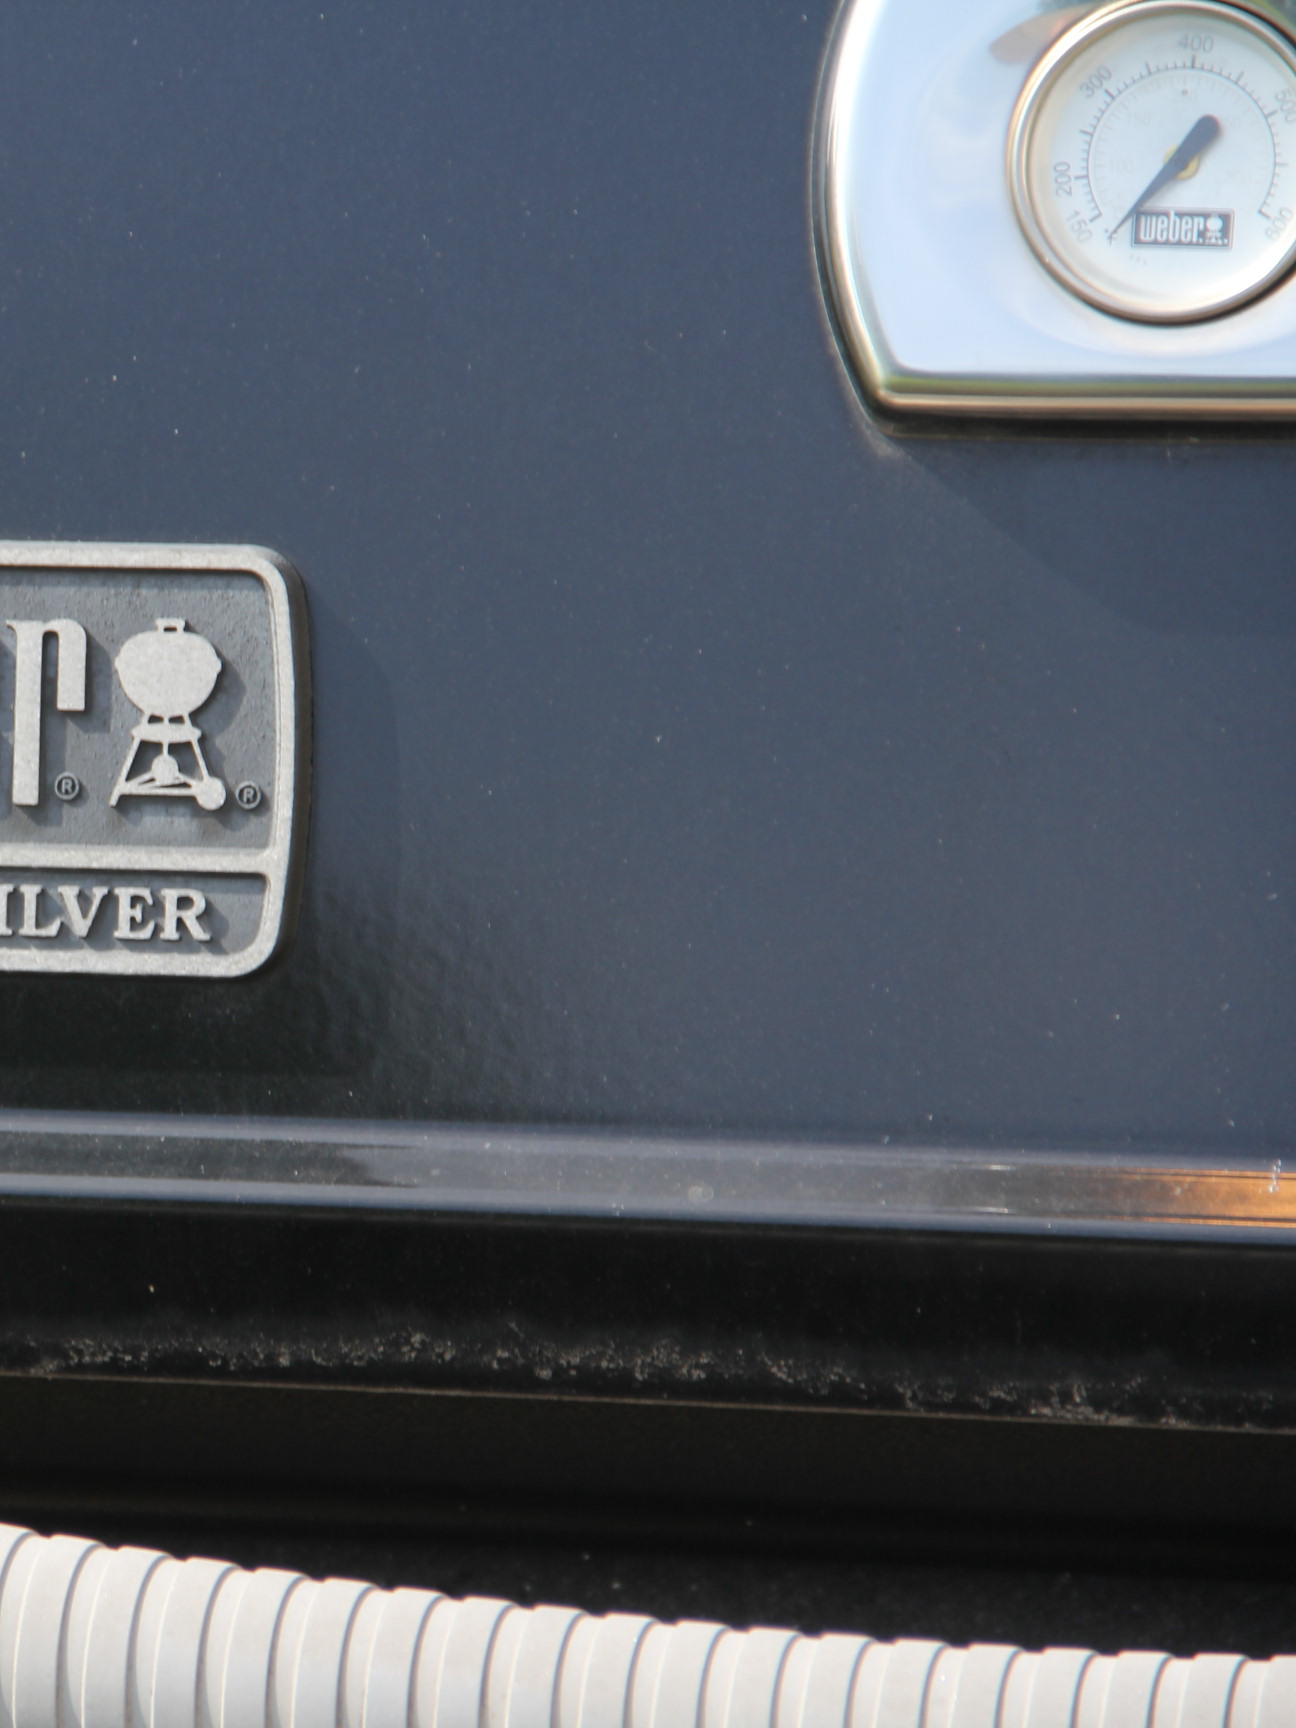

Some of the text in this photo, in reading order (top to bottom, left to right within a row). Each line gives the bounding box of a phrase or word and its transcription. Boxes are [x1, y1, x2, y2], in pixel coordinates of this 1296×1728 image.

[1177, 34, 1215, 53] 400
[1079, 65, 1113, 99] 300
[1052, 161, 1072, 198] 200
[1065, 210, 1093, 242] 150
[1139, 210, 1200, 244] weber
